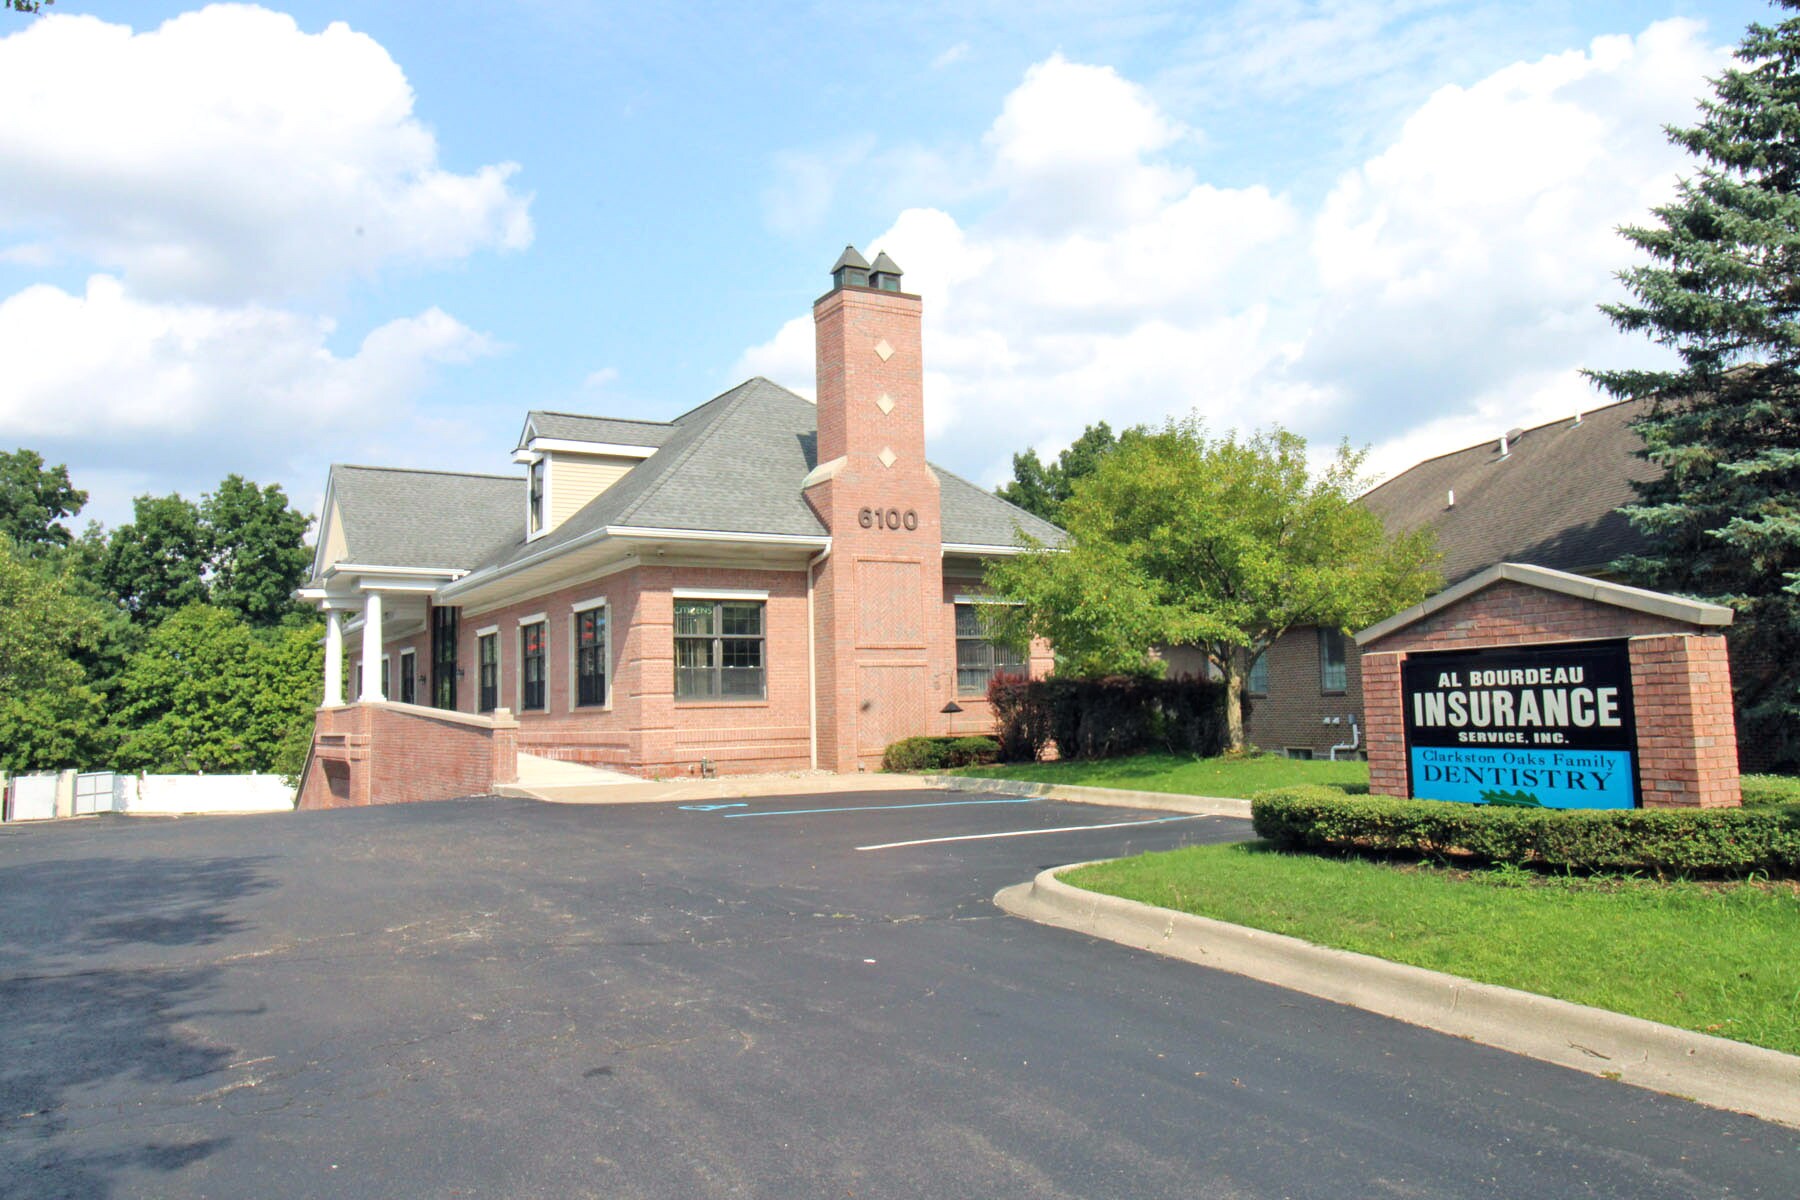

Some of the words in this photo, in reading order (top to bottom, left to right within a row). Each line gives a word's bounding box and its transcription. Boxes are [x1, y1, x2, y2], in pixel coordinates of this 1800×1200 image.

[858, 507, 918, 531] 6100
[1438, 672, 1462, 688] AL
[1469, 667, 1584, 687] BOURDEAU
[1413, 687, 1622, 727] INSURANCE
[1533, 732, 1570, 744] INC.
[1422, 749, 1496, 764] Clarkston
[1503, 751, 1545, 765] Oaks
[1554, 753, 1616, 770] Family
[1423, 764, 1612, 791] DENTISTRY
